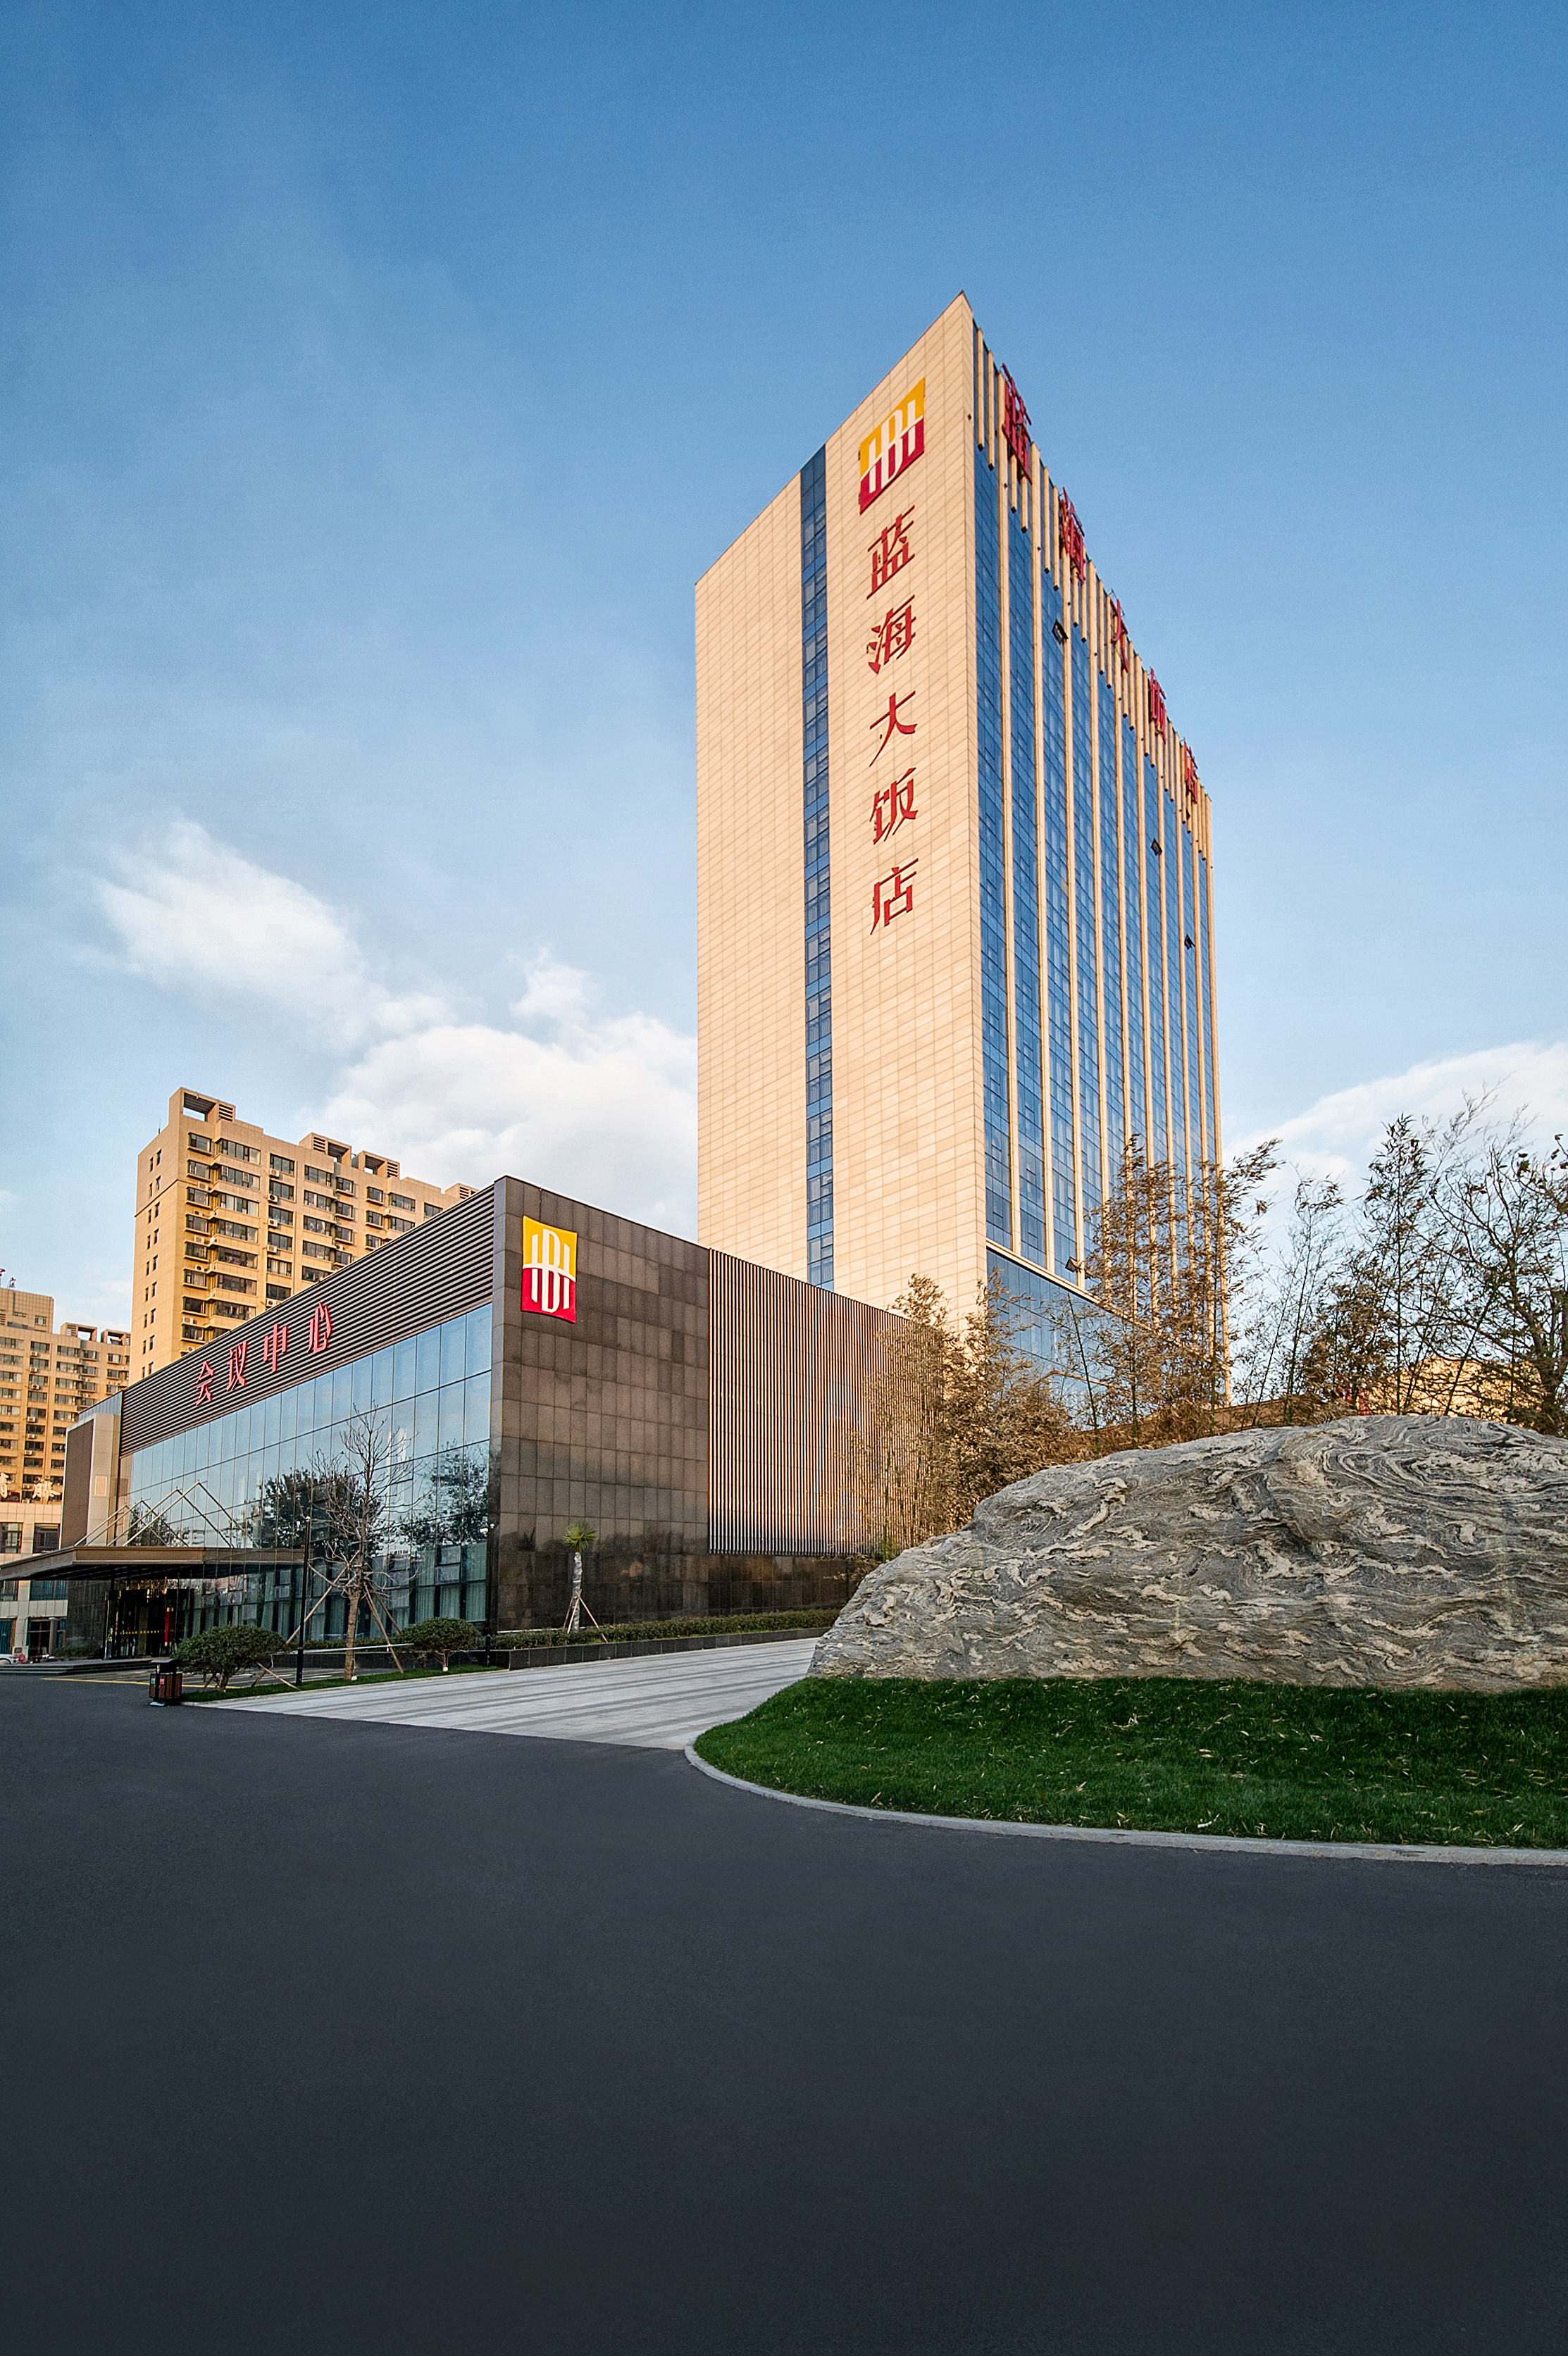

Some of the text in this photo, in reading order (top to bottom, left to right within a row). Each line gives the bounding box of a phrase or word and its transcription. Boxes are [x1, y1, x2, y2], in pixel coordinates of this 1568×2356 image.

[866, 504, 919, 936] 蓝海大饭店
[195, 1301, 332, 1407] 会议中心
